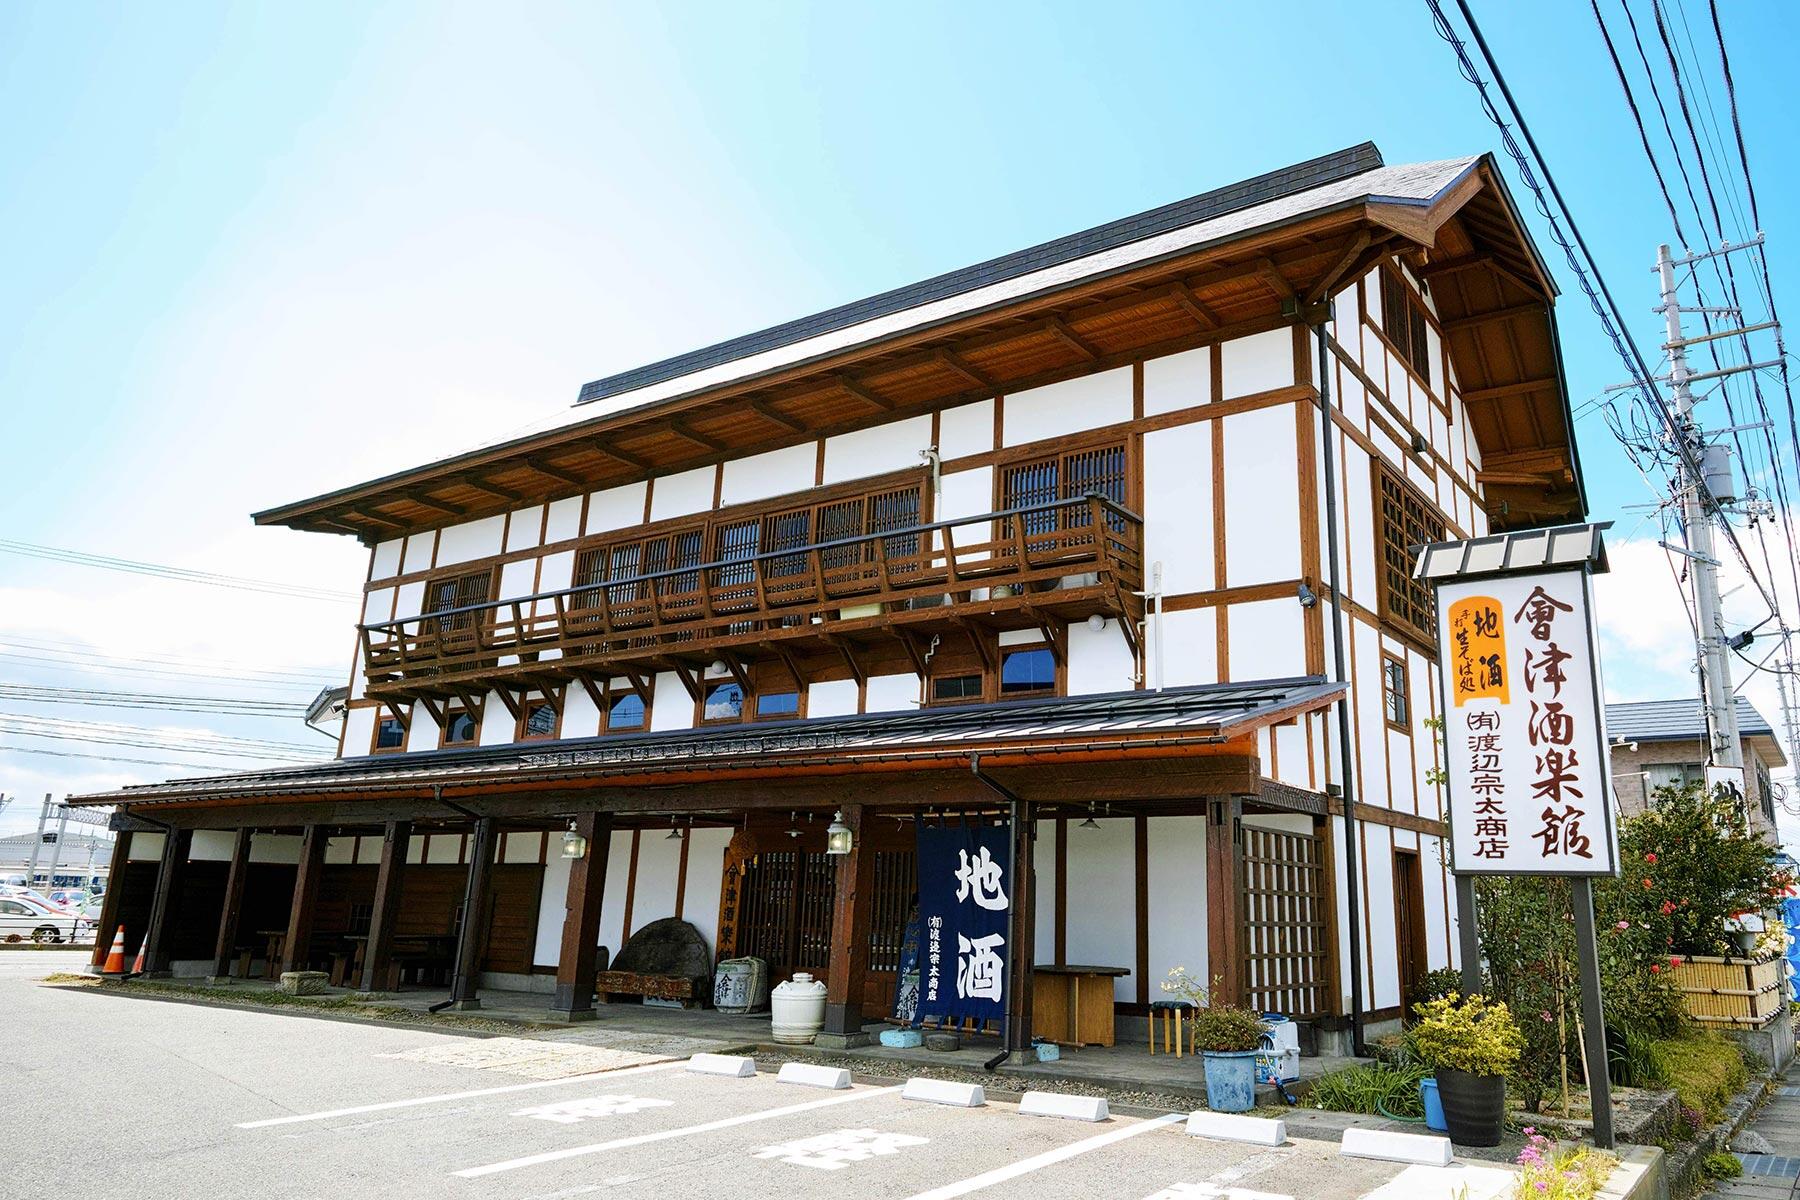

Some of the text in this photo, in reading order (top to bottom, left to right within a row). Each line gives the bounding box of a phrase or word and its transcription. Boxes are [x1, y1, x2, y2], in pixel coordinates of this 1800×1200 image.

[1473, 606, 1503, 690] 地酒
[1514, 586, 1594, 859] 會津酒楽館
[954, 846, 1009, 1002] 地酒
